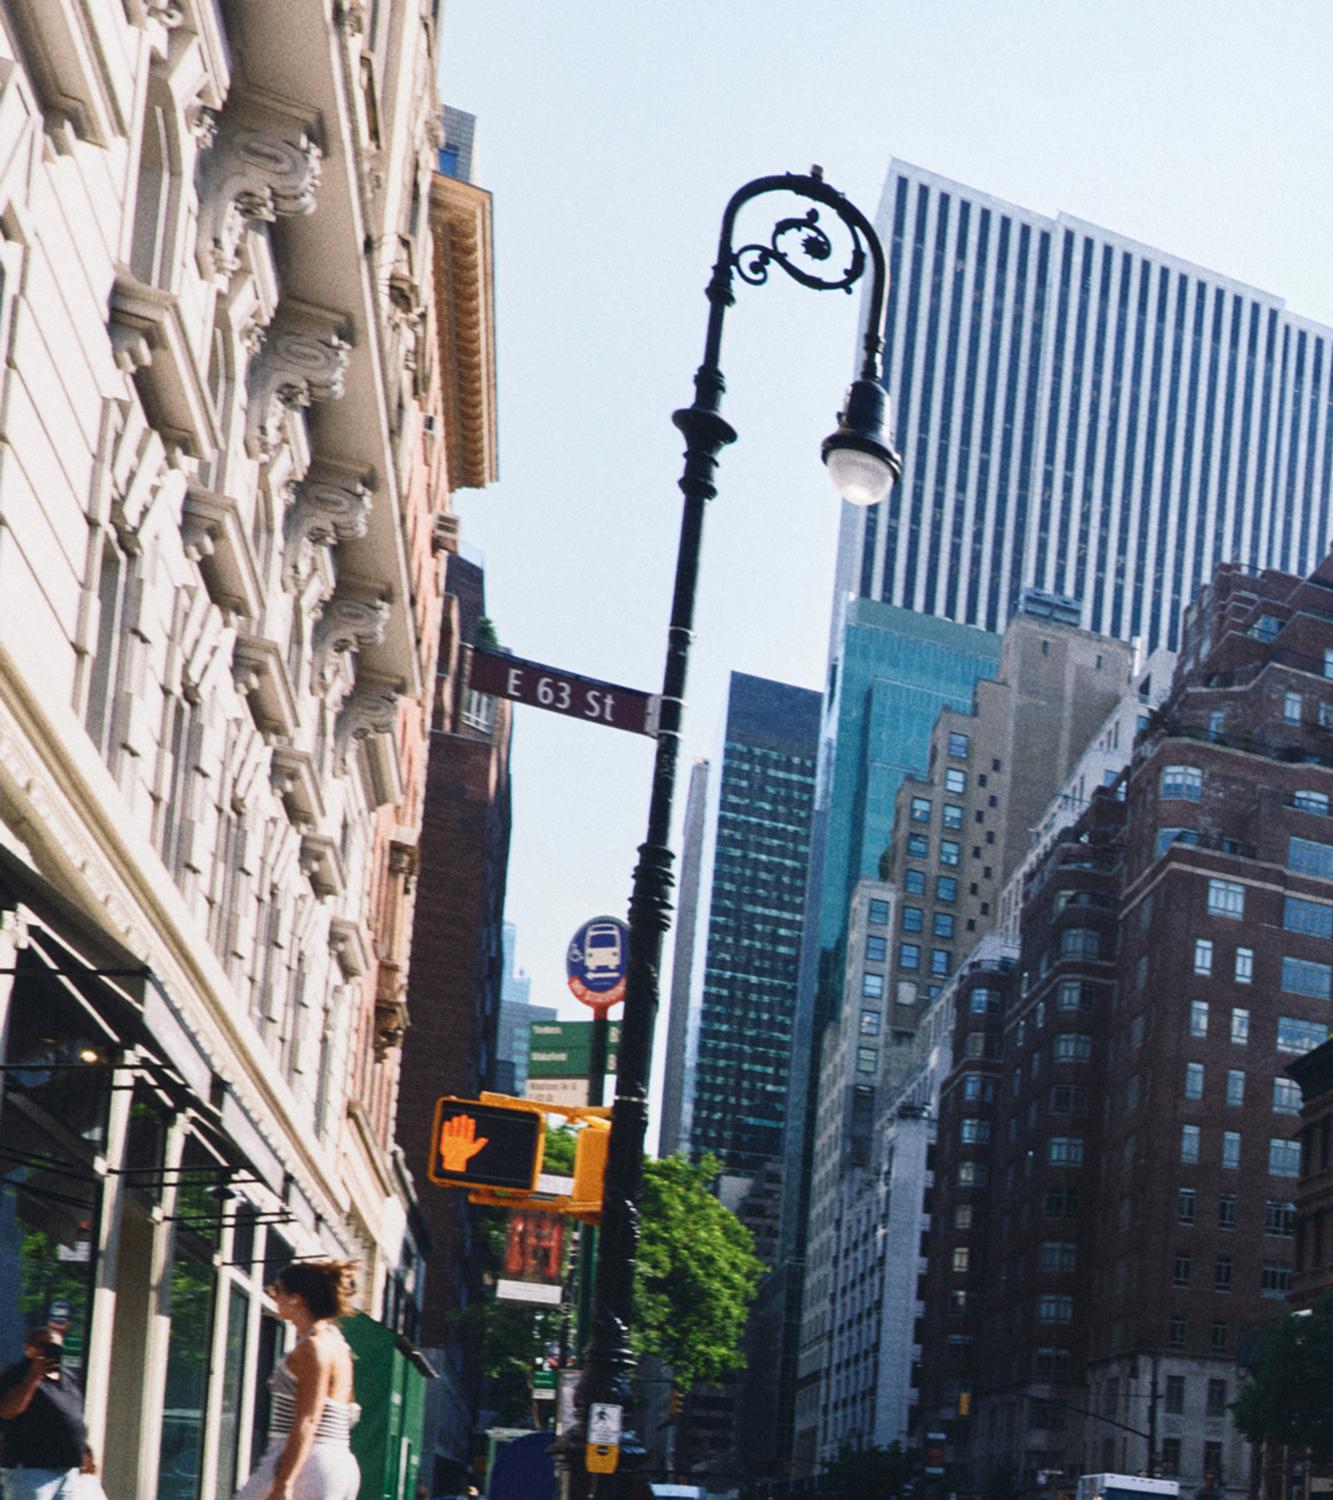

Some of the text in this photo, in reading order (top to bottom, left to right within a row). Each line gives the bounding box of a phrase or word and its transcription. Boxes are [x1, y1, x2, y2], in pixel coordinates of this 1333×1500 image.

[507, 668, 615, 721] E 63 St
